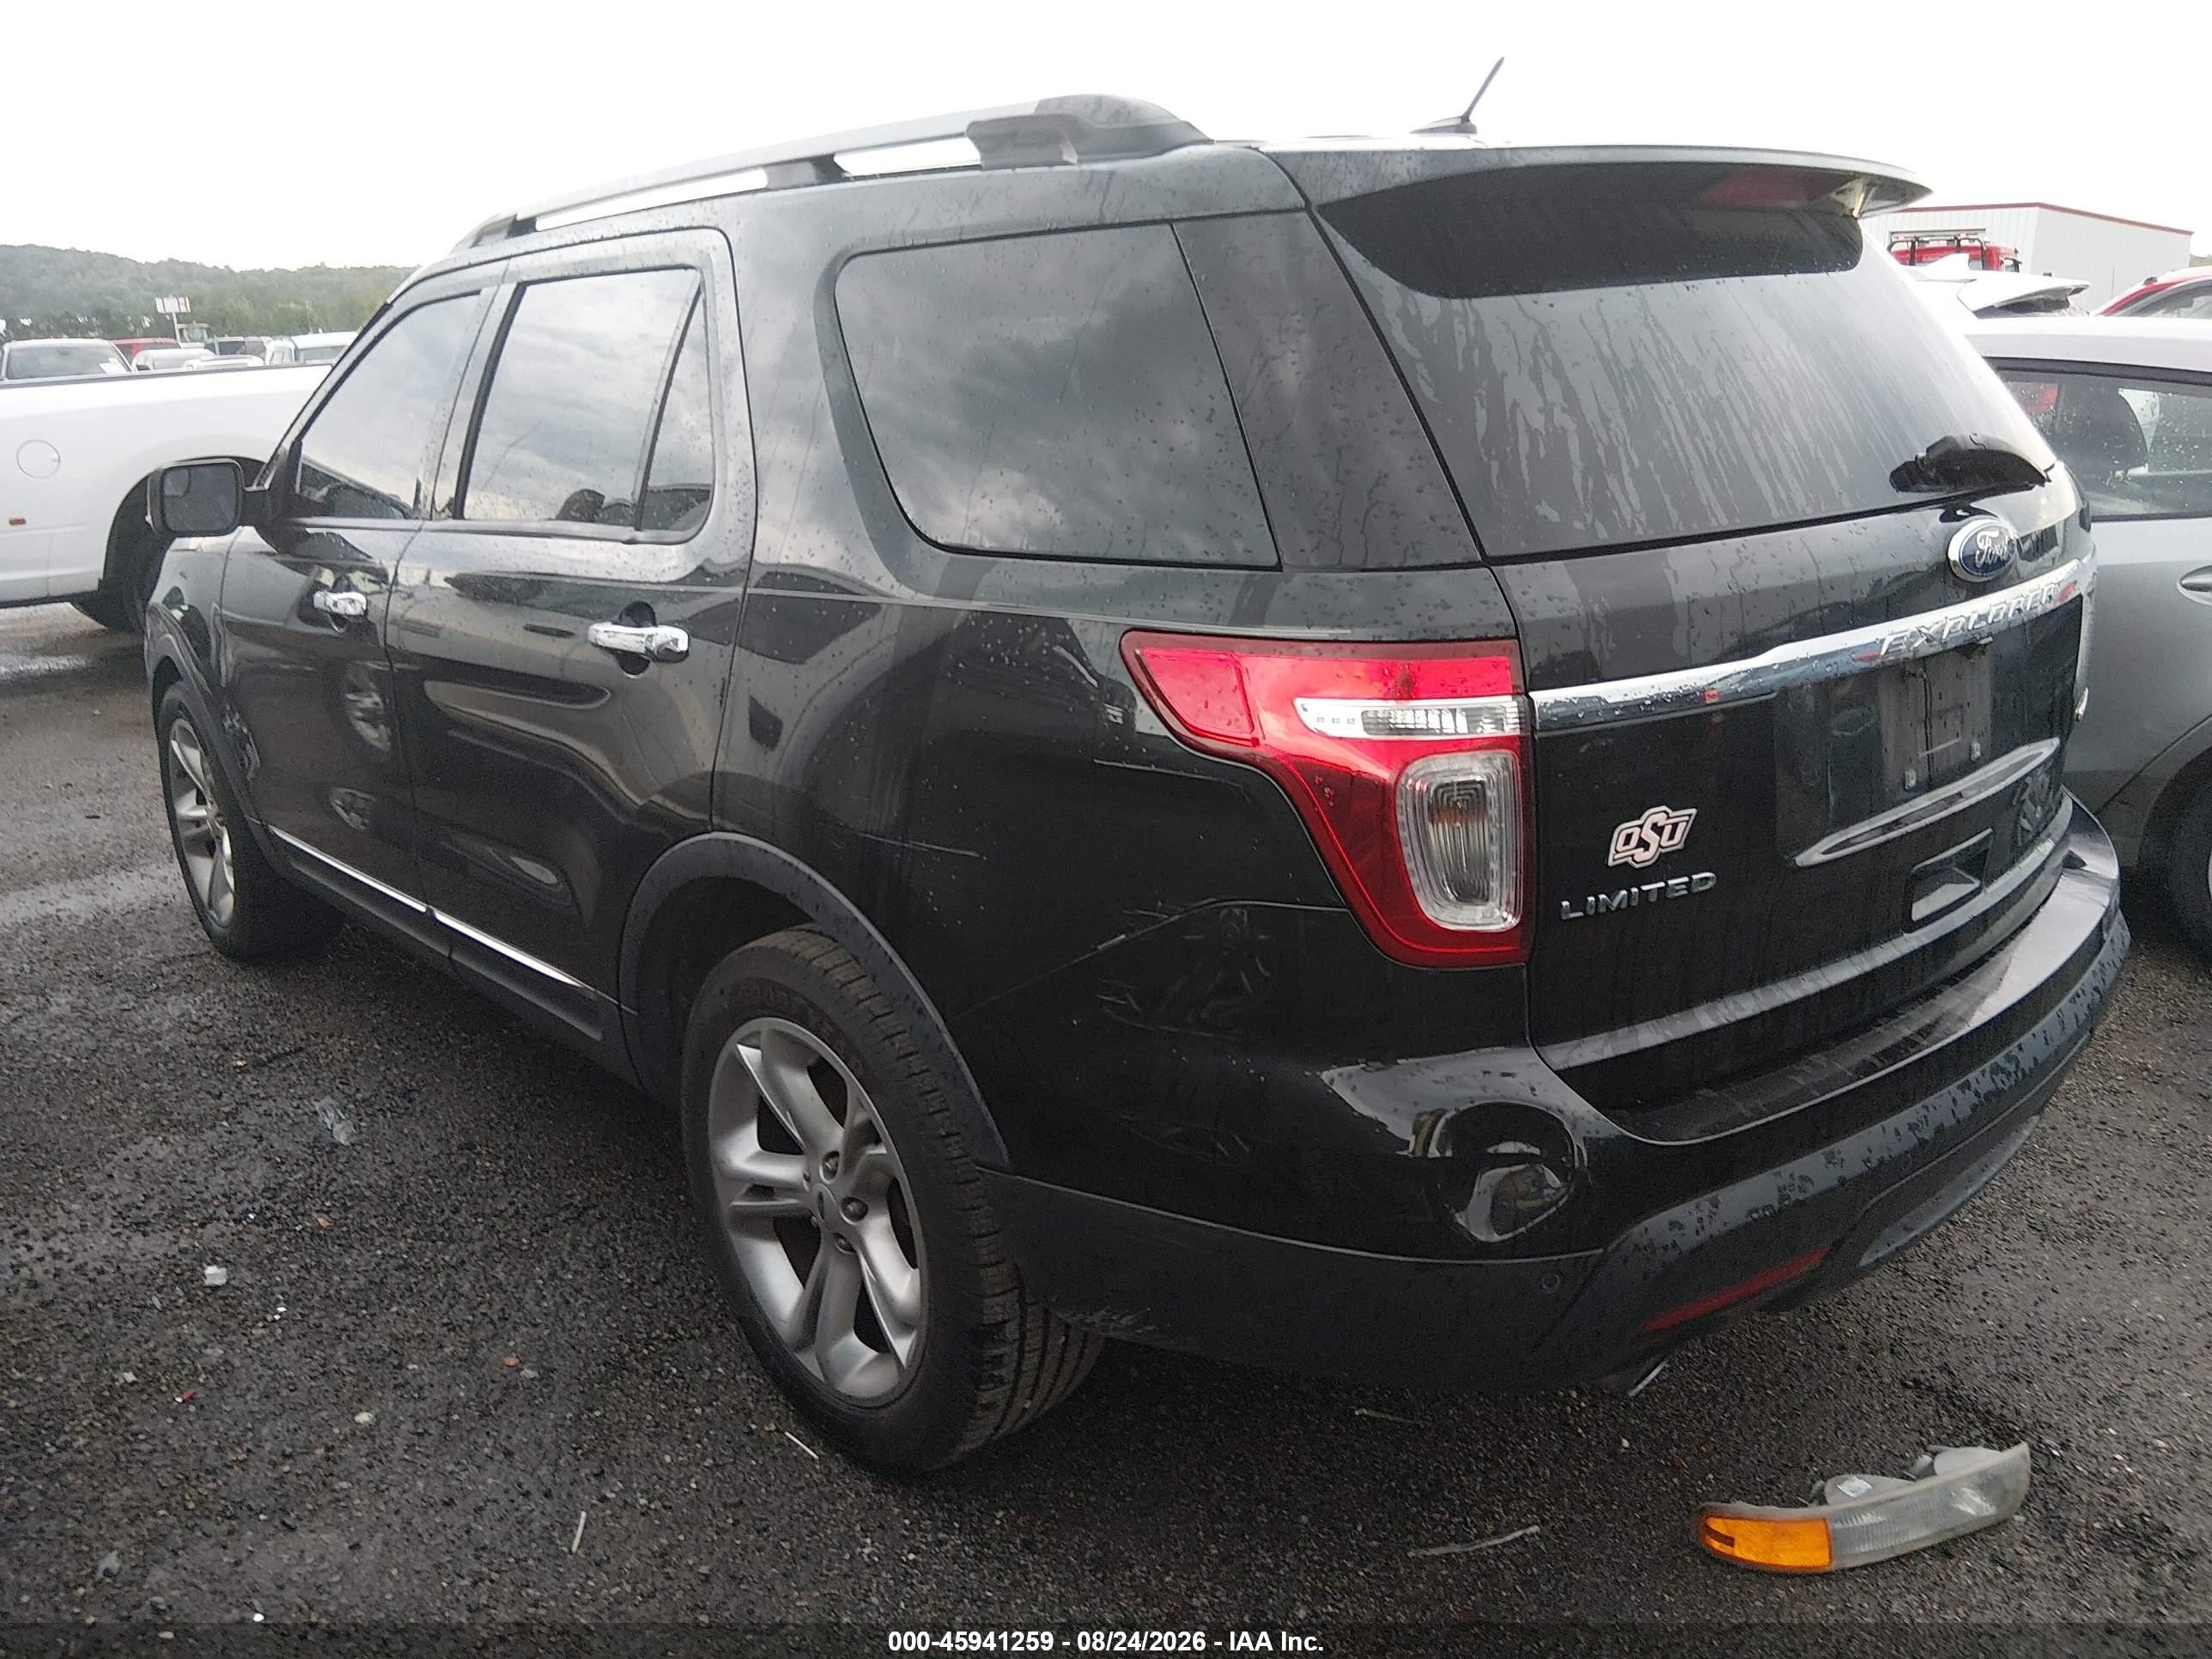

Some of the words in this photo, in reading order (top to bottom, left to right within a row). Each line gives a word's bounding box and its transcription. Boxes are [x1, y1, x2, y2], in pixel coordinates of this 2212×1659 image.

[1975, 529, 2008, 568] Ford
[1878, 583, 2060, 656] EXPLORER
[1612, 810, 1692, 866] OSU
[1560, 872, 1717, 921] LIMITED
